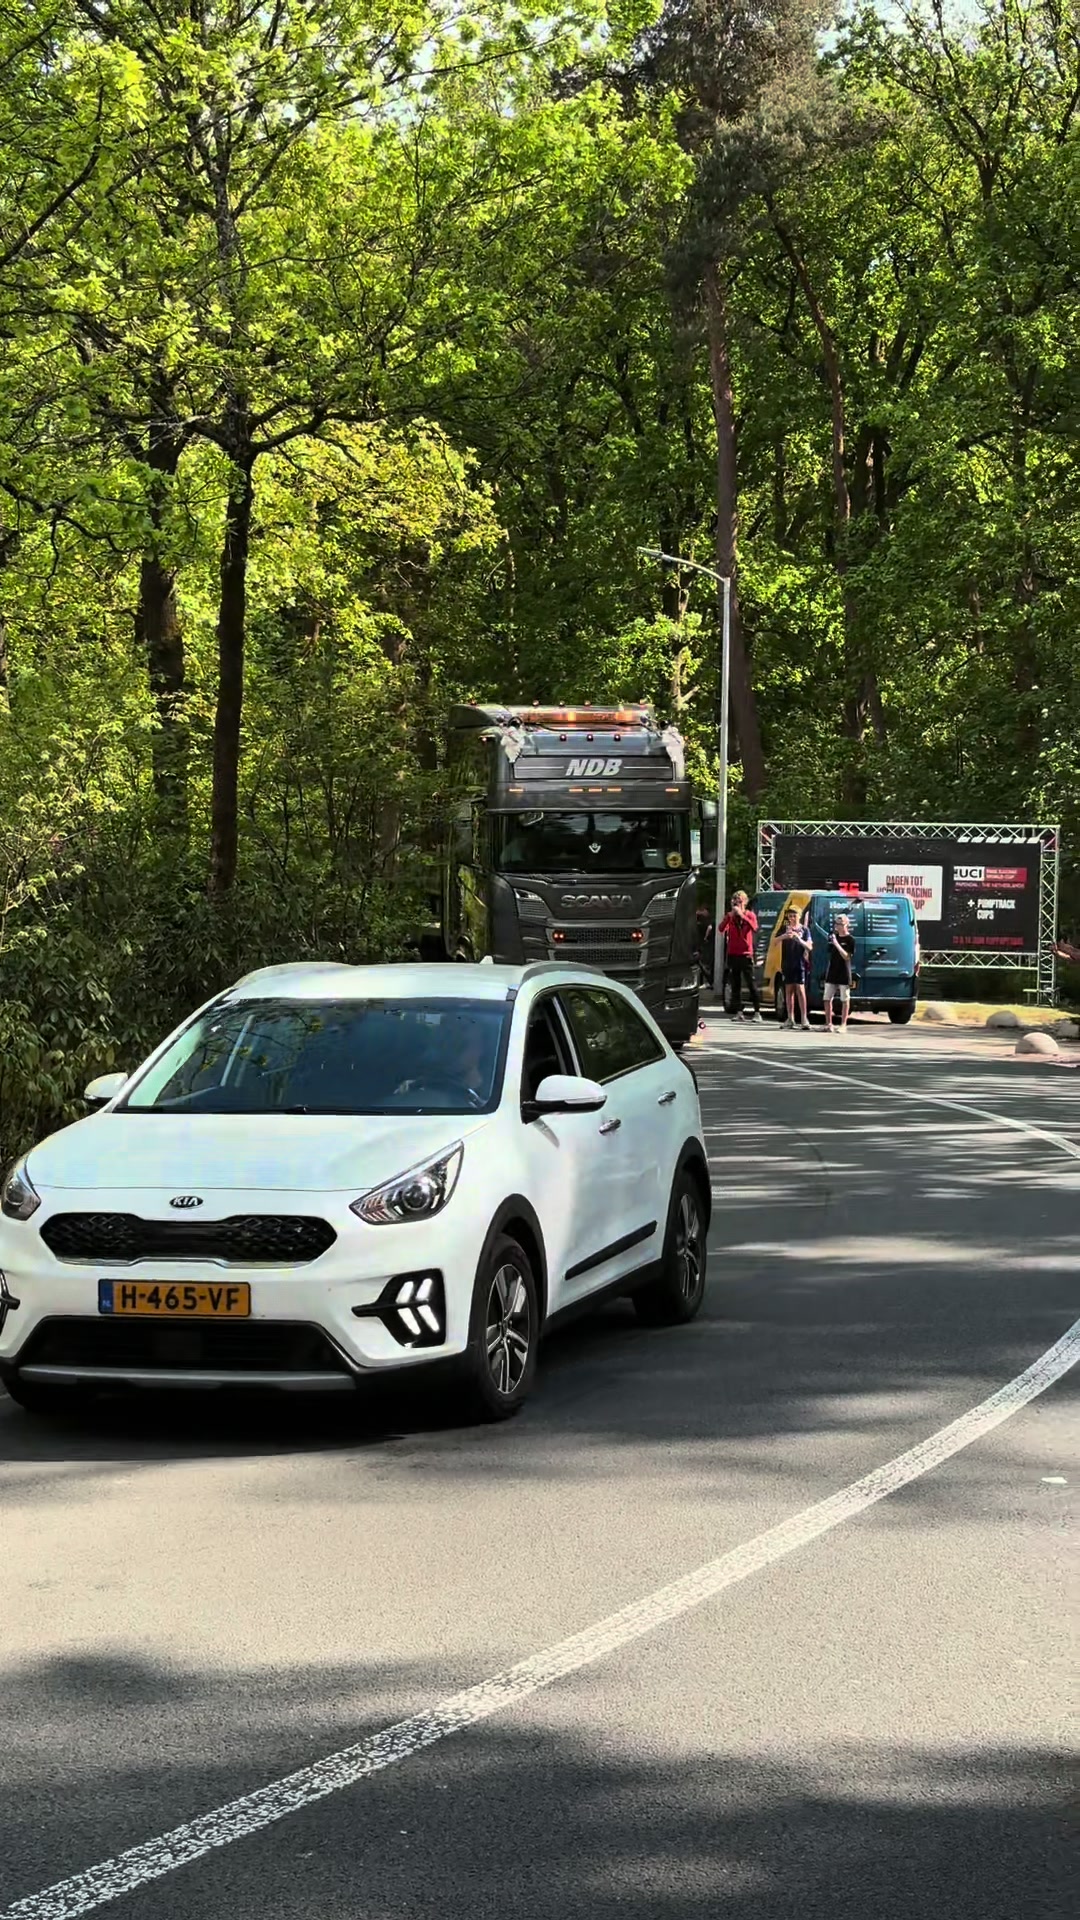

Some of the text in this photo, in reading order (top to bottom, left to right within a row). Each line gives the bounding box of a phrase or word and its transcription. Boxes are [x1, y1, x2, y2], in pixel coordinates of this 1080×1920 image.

[565, 758, 623, 776] NDB
[959, 868, 983, 879] UCI
[910, 875, 924, 886] TOT
[560, 894, 633, 909] SCANIA
[172, 1197, 198, 1206] KIA
[121, 1284, 240, 1311] H-465-VF
